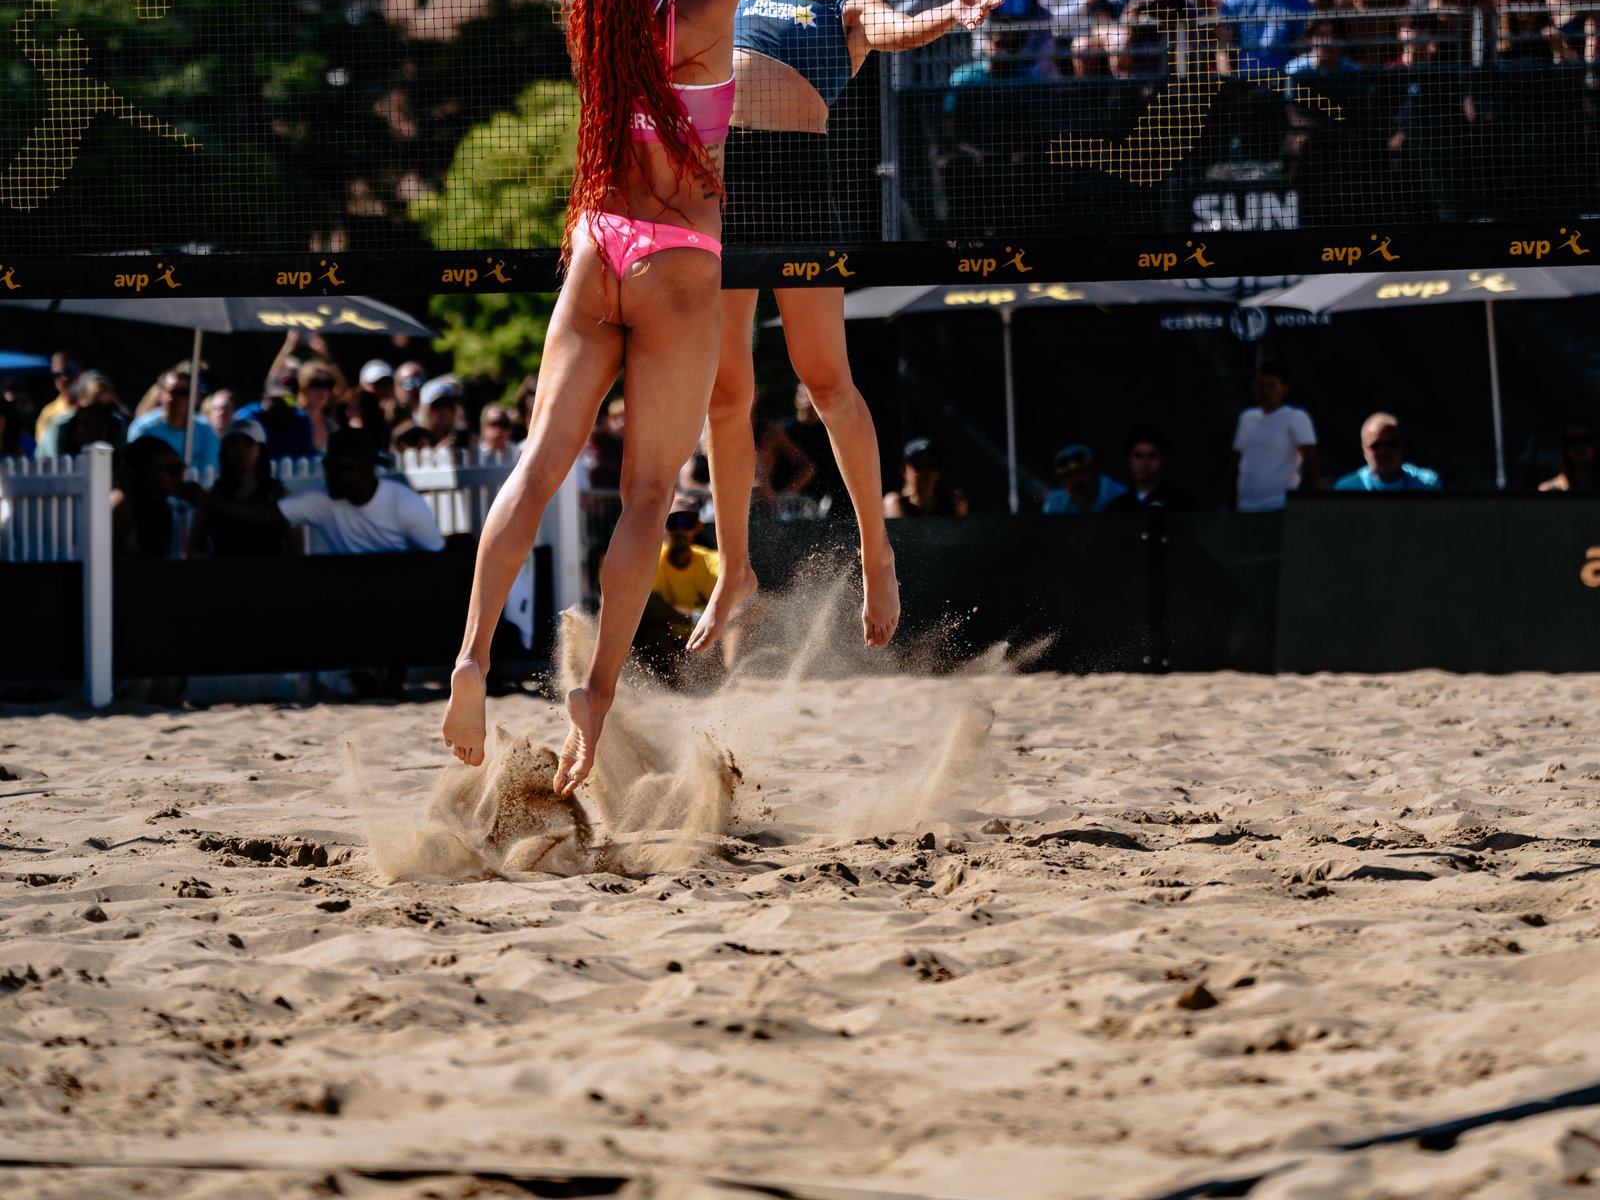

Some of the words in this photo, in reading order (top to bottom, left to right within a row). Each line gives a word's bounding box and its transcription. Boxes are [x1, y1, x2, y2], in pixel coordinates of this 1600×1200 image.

[1191, 187, 1299, 232] SUN
[1321, 246, 1361, 266] avp
[1509, 240, 1550, 260] avp
[782, 262, 820, 281] avp
[958, 258, 997, 276] avp
[1138, 253, 1176, 272] avp
[114, 274, 149, 292] avp
[276, 271, 312, 289] avp
[441, 268, 478, 287] avp
[1375, 280, 1450, 299] avp
